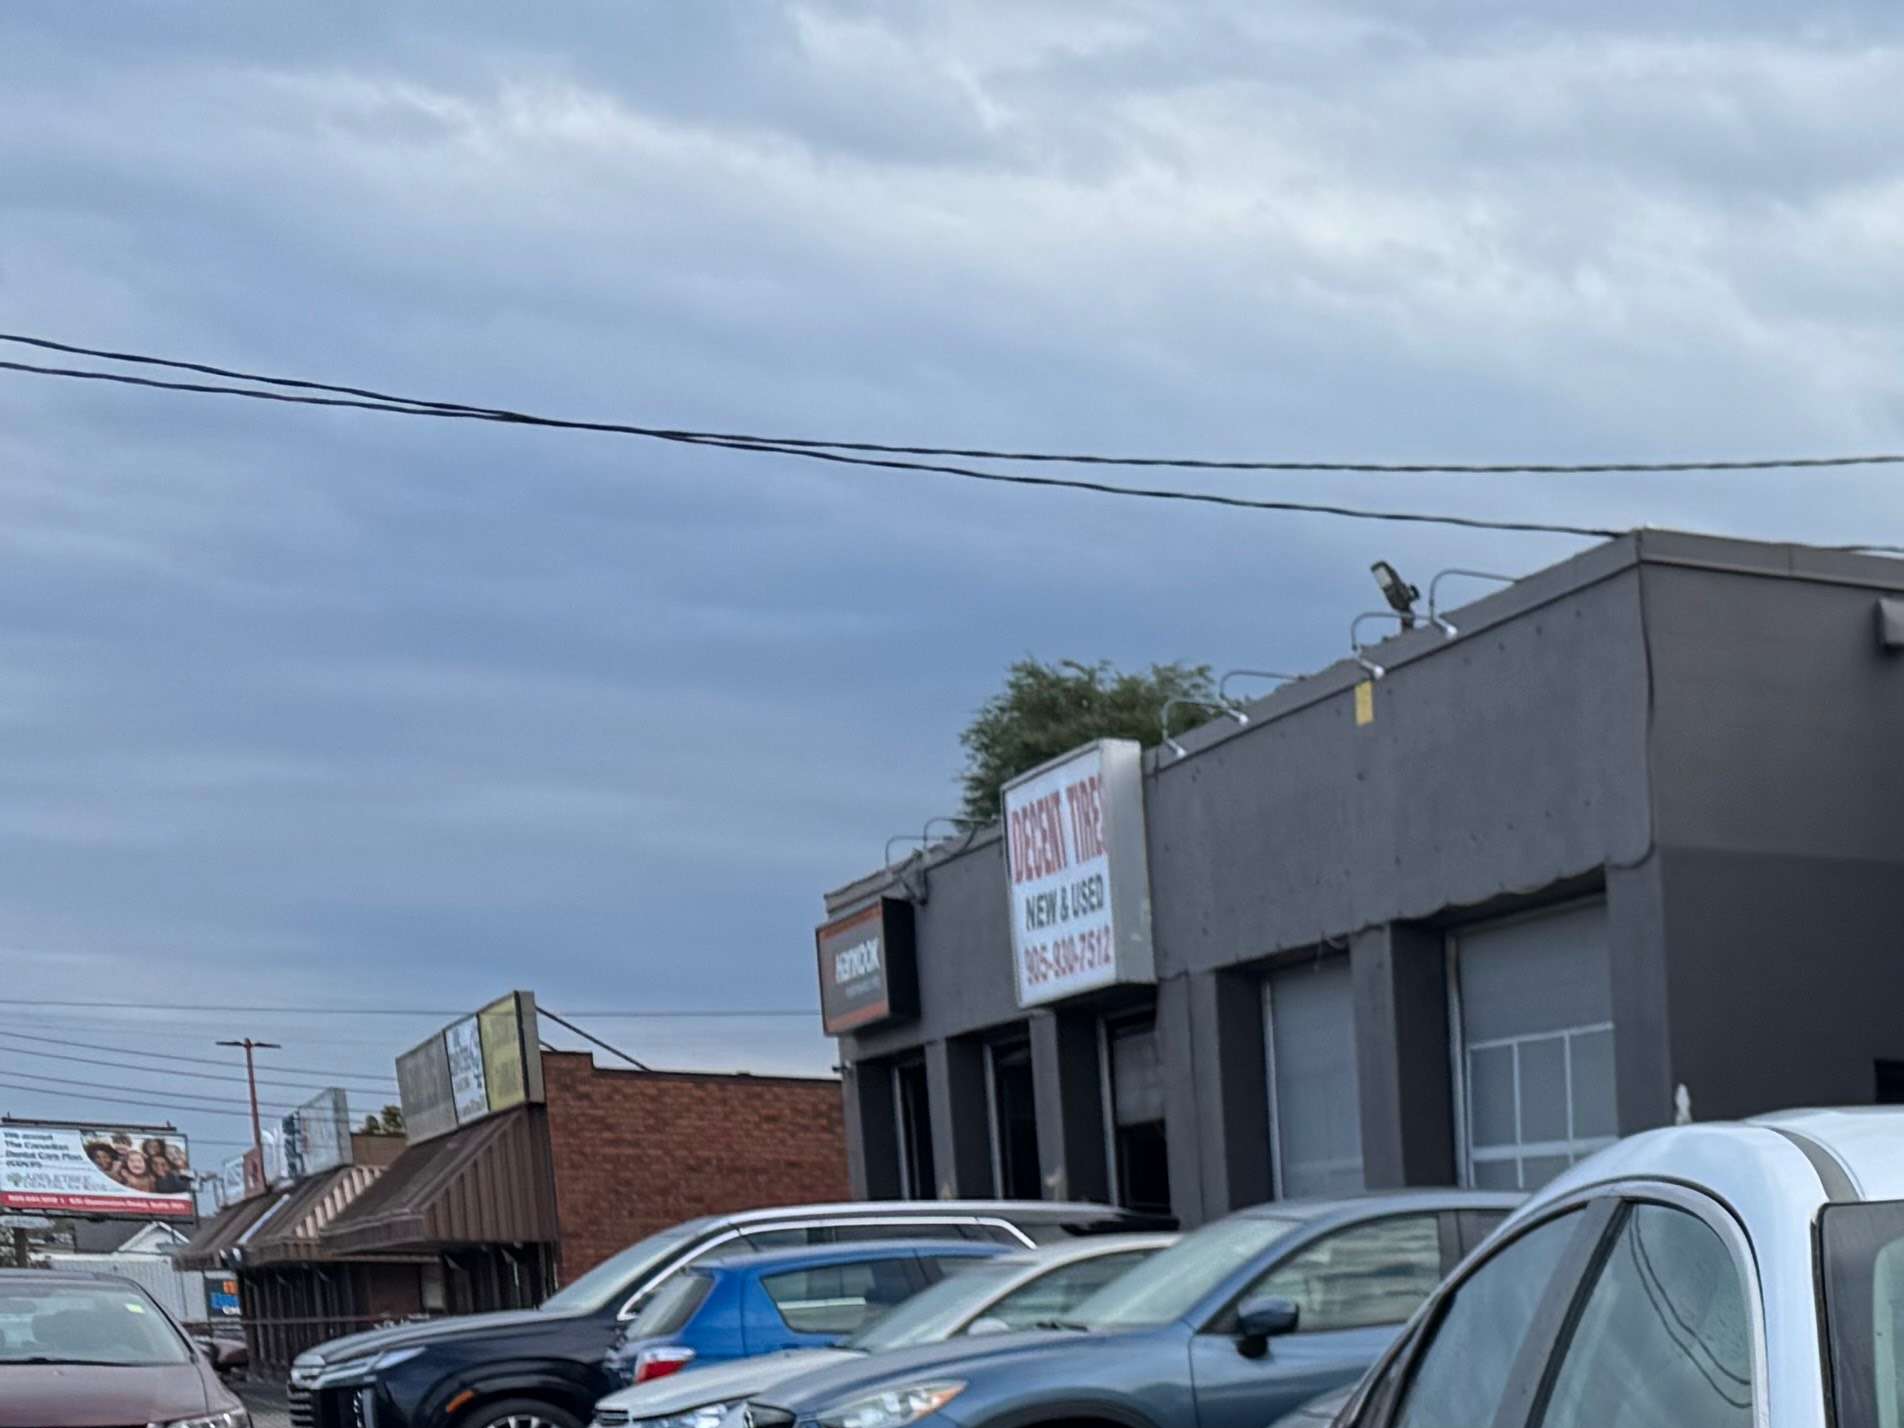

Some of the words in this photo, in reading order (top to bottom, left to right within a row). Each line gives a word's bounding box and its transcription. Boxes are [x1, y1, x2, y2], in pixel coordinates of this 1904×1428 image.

[1011, 791, 1067, 884] DECENT
[1025, 890, 1056, 931] NEW
[1060, 886, 1069, 922] &
[1071, 873, 1104, 918] USED
